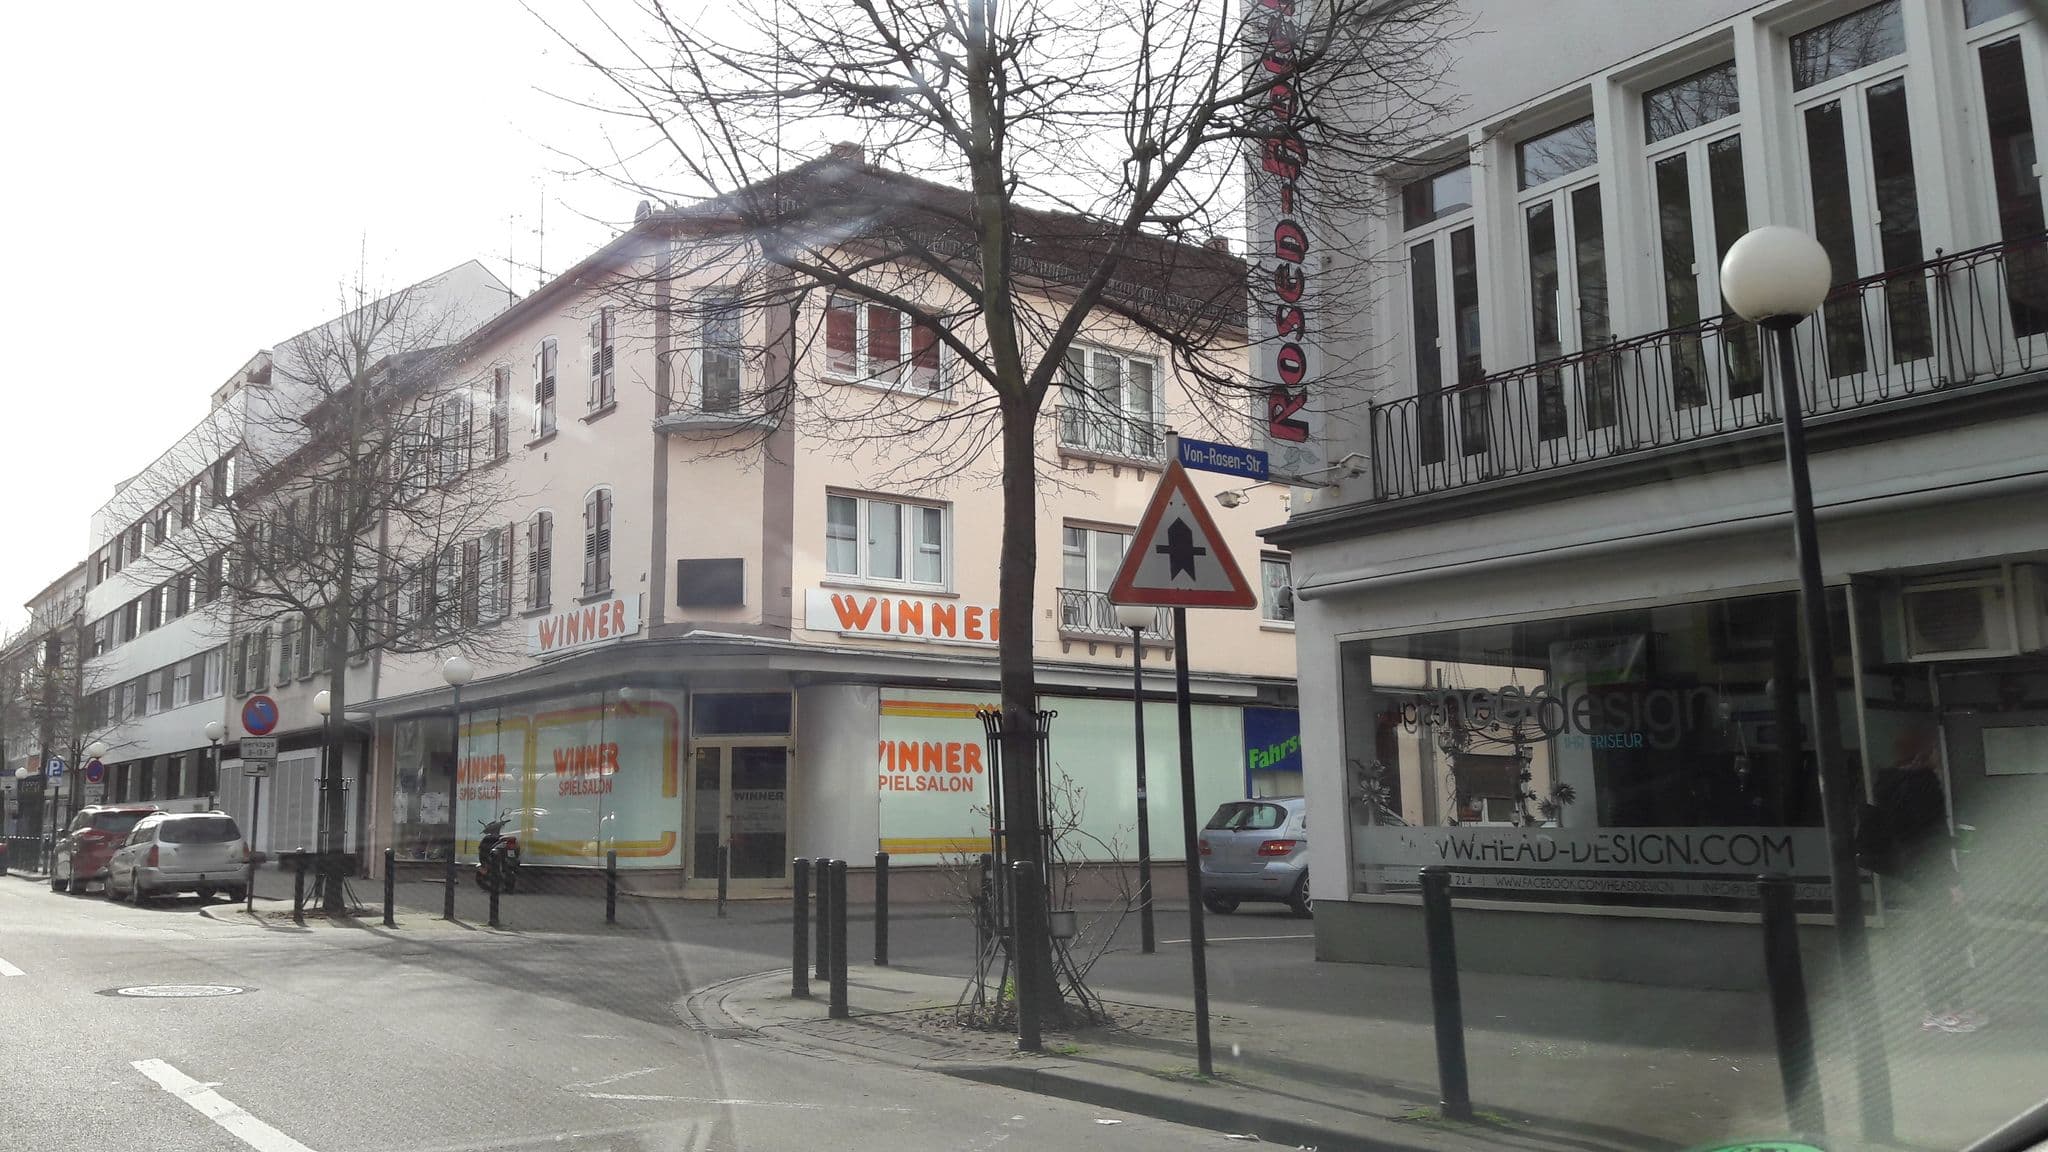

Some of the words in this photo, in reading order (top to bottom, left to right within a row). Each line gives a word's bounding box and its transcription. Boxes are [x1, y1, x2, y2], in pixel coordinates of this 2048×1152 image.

[1183, 443, 1264, 474] Von-Rosen-Str.
[538, 599, 626, 651] WINNER
[1590, 733, 1643, 750] FRISEUR
[49, 760, 61, 777] P
[457, 753, 506, 785] WINNER
[553, 742, 620, 777] WINNER
[879, 740, 984, 774] INNER
[558, 778, 613, 796] SPIELSALON
[879, 775, 974, 792] PIELSALON
[734, 791, 785, 801] WINNER
[1401, 833, 1795, 868] W.HEAD-DESIGN.COM
[1456, 875, 1473, 886] 214
